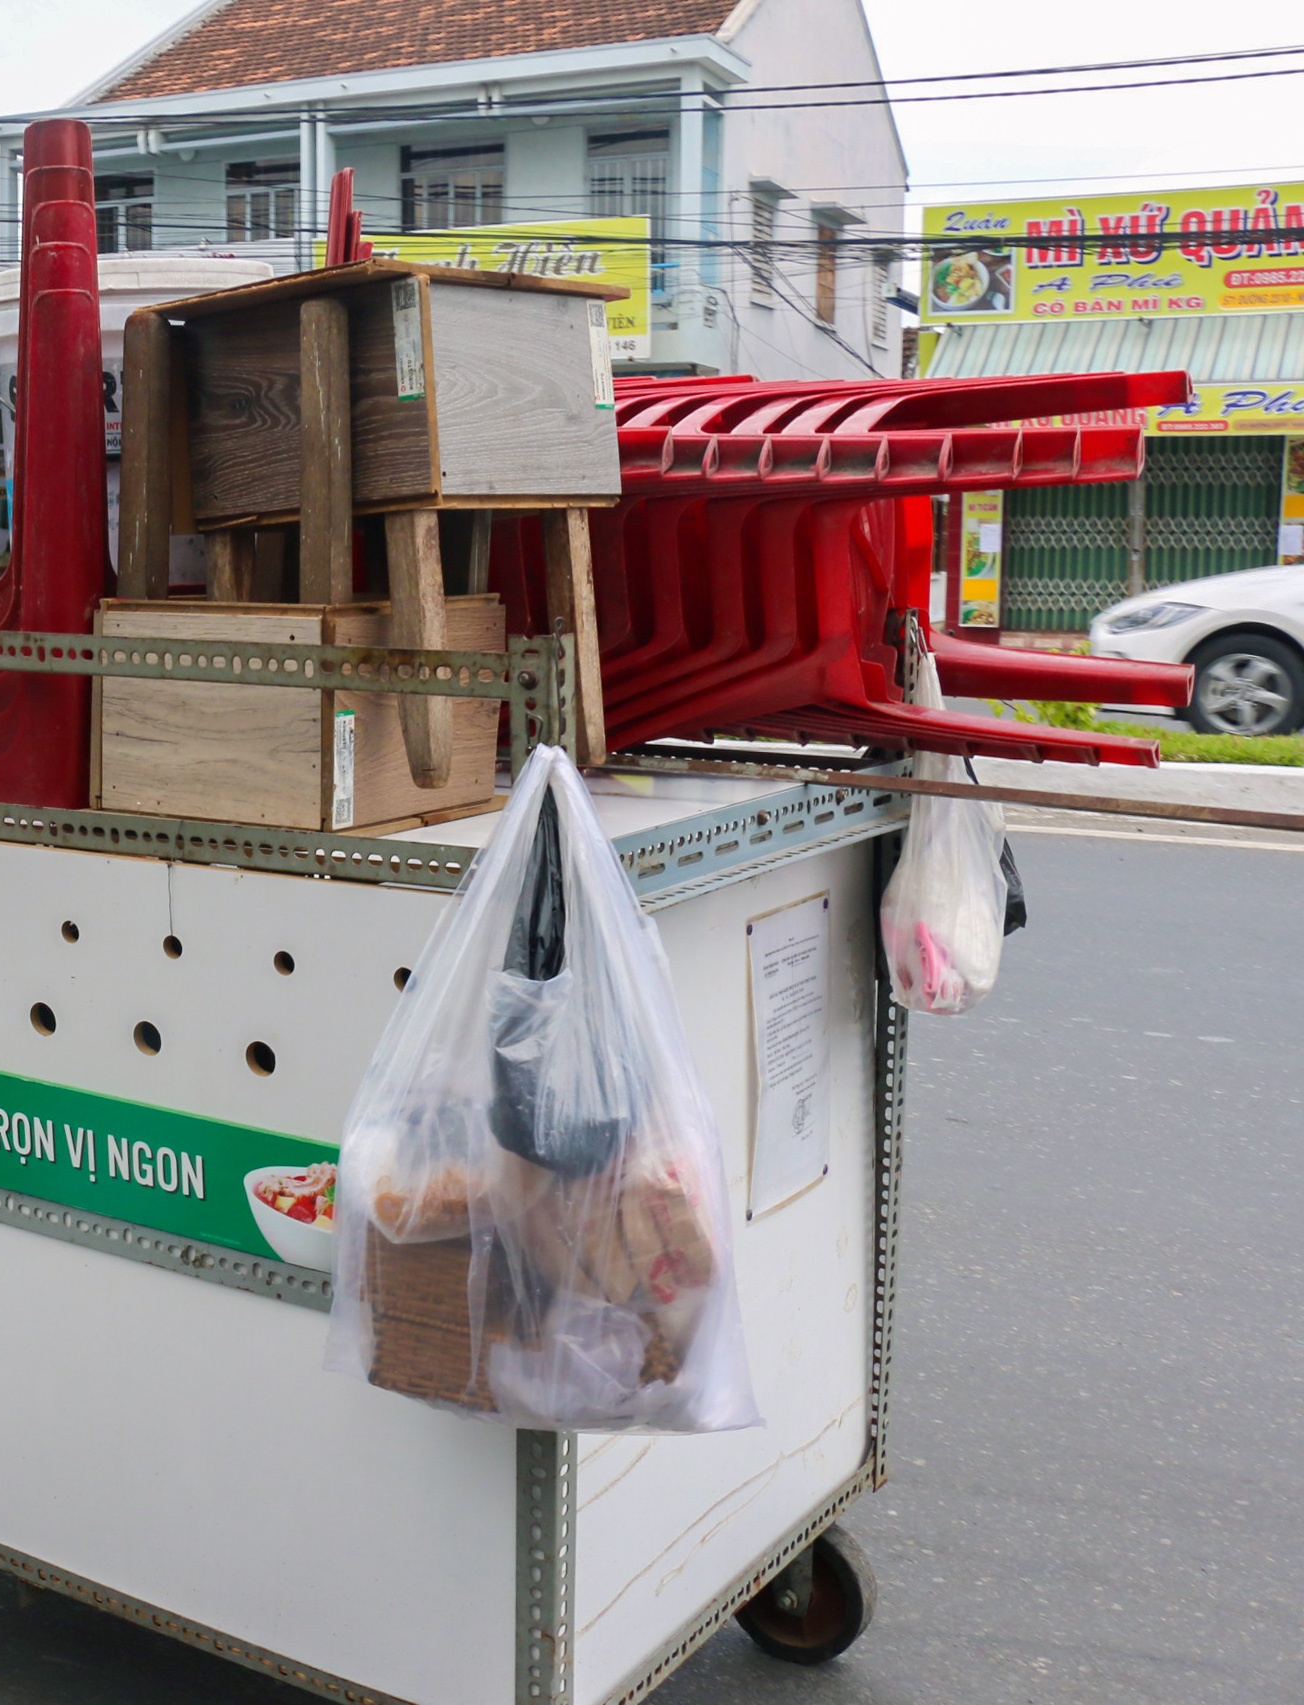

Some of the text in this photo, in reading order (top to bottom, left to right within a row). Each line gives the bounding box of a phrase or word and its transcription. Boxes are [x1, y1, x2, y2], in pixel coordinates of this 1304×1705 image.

[1025, 208, 1083, 267] MÌ
[1179, 189, 1304, 267] QUẢN
[1167, 296, 1204, 309] KG
[64, 1119, 96, 1183] VỊ
[107, 1134, 206, 1200] NGON
